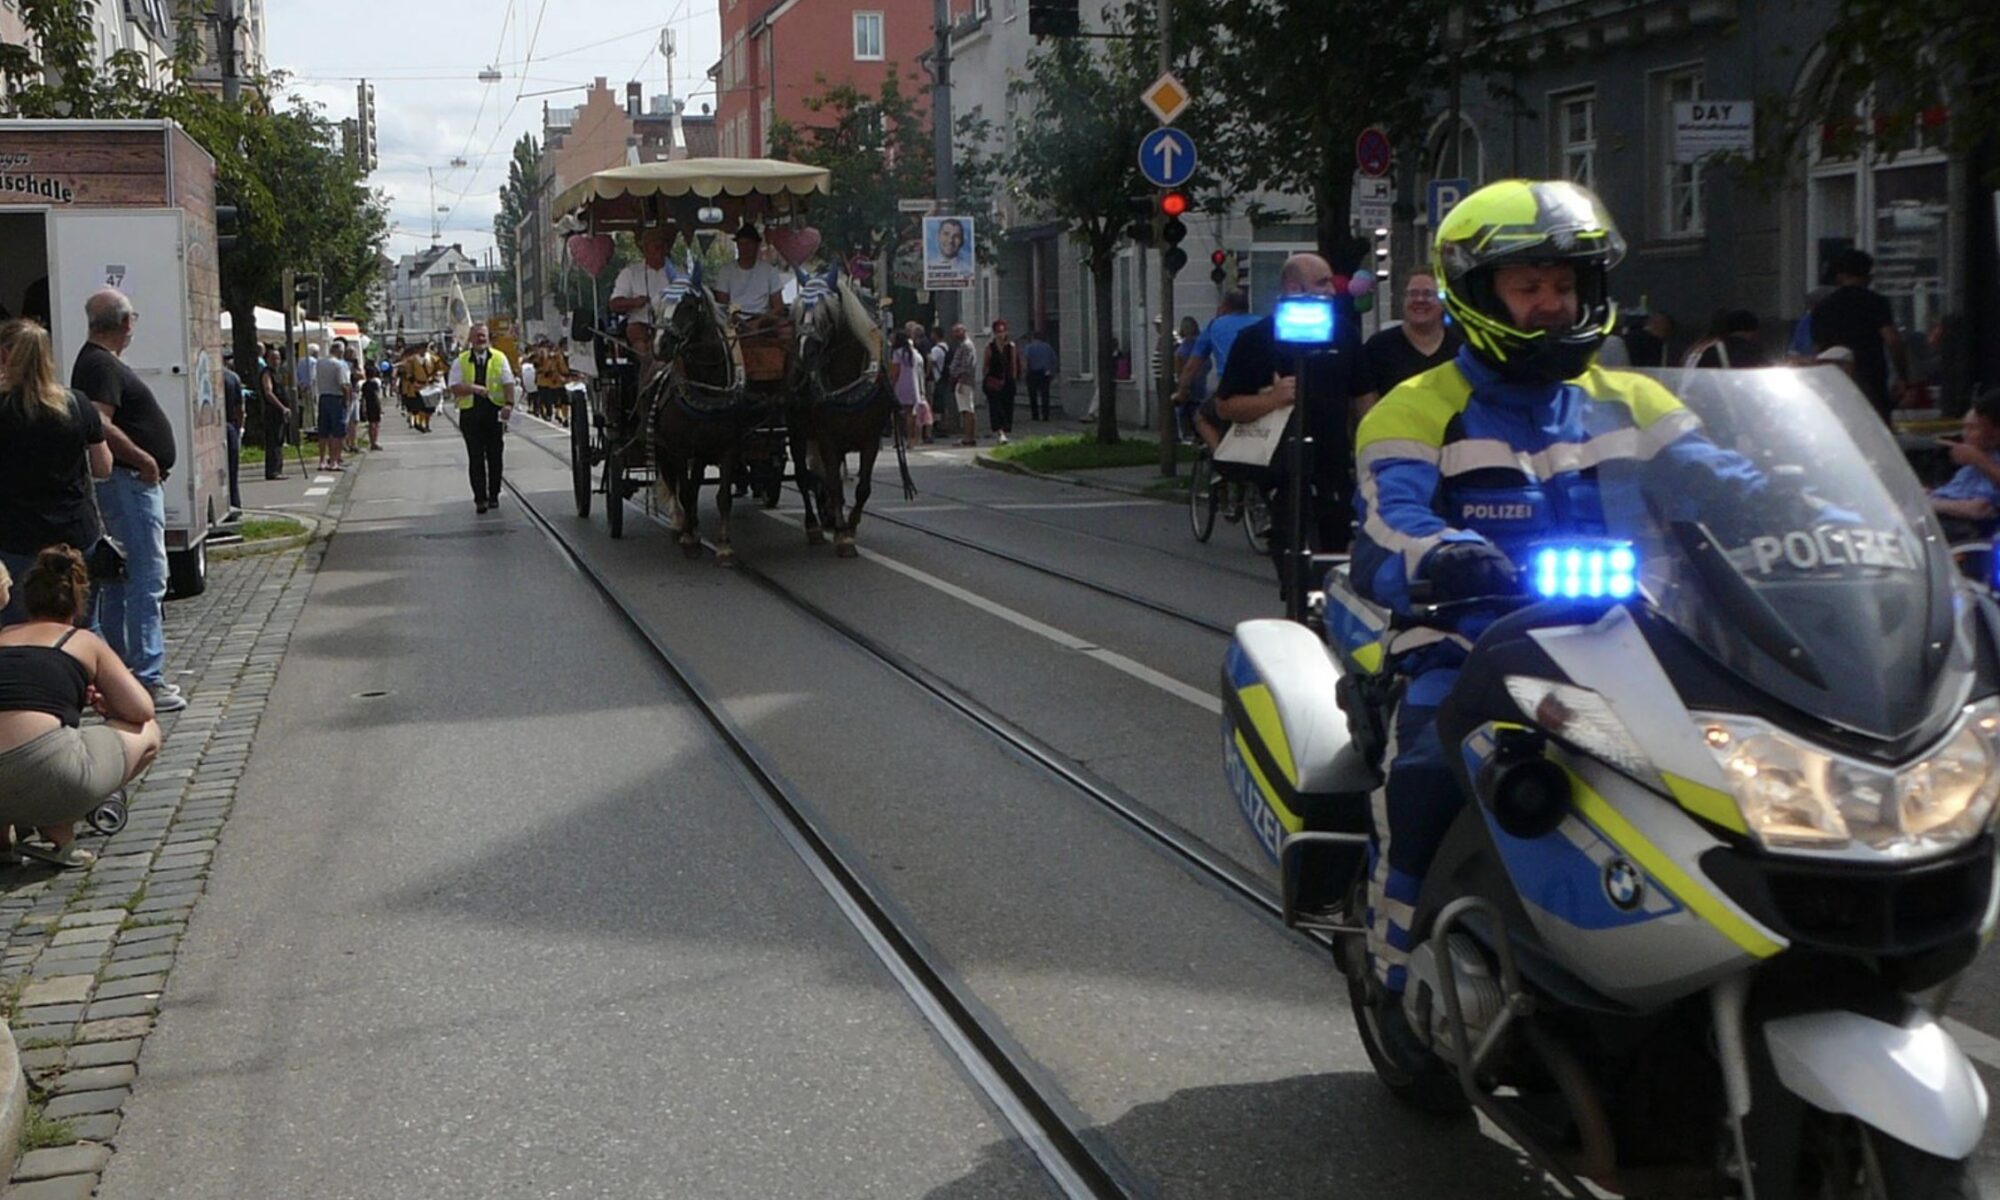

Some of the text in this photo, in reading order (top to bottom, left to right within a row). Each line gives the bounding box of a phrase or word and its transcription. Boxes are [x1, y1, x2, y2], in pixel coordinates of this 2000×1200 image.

[1692, 104, 1733, 121] DAY
[106, 274, 124, 288] 47
[1462, 504, 1532, 519] POLIZEI
[1750, 525, 1917, 575] POLIZEI
